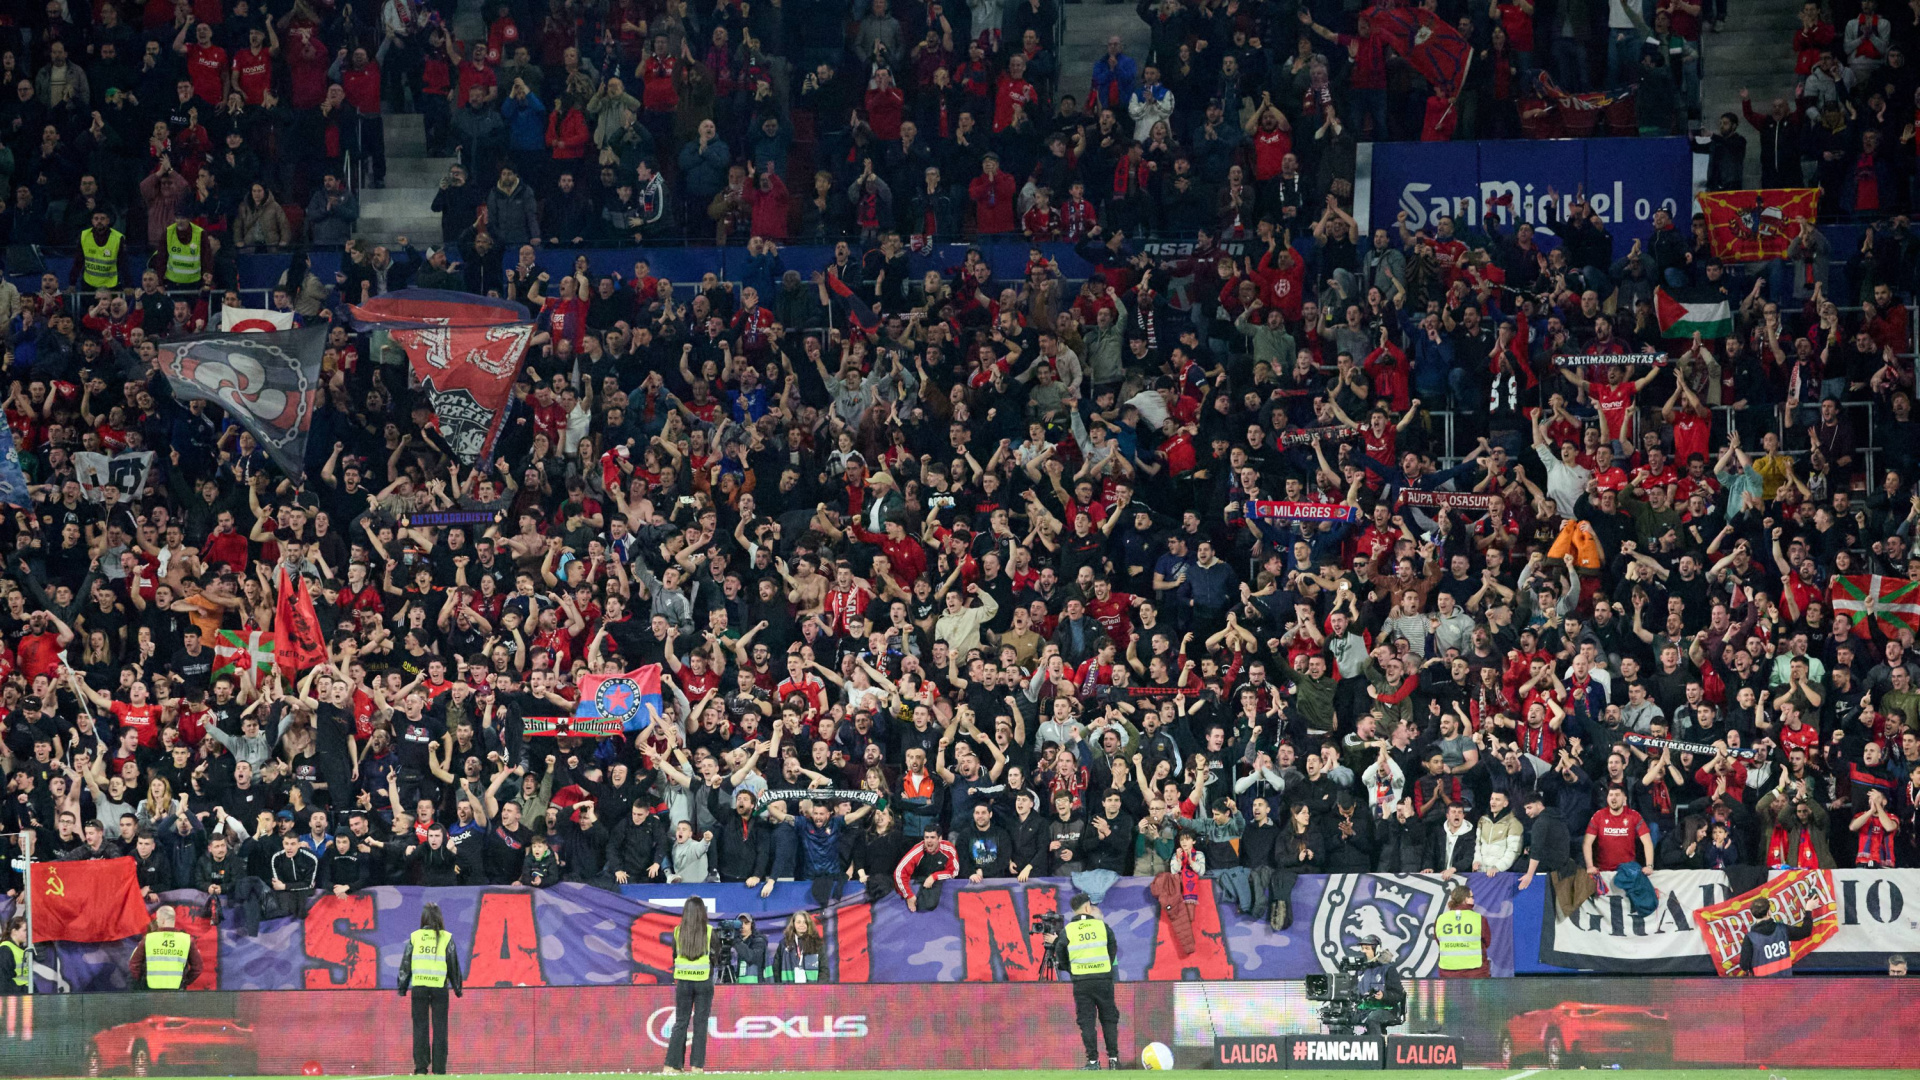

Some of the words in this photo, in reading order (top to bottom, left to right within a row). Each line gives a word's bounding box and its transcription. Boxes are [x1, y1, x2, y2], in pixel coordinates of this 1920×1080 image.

[1567, 354, 1654, 365] ANTIMADRIDISTAS
[1407, 491, 1433, 503] AUPA
[1449, 494, 1491, 507] OSASUN
[1273, 505, 1331, 518] MILAGRES
[411, 512, 493, 525] ANTIMADRIDISTA
[1442, 923, 1473, 935] G10
[1078, 931, 1097, 942] 303
[161, 940, 176, 948] 45
[418, 946, 437, 955] 360
[1763, 941, 1787, 960] 028
[152, 948, 184, 957] SEGURIDAD
[707, 1015, 869, 1038] LEXUS
[1220, 1043, 1279, 1064] LALIGA
[1292, 1041, 1379, 1062] #FANCAM
[1396, 1044, 1458, 1065] LALIGA
